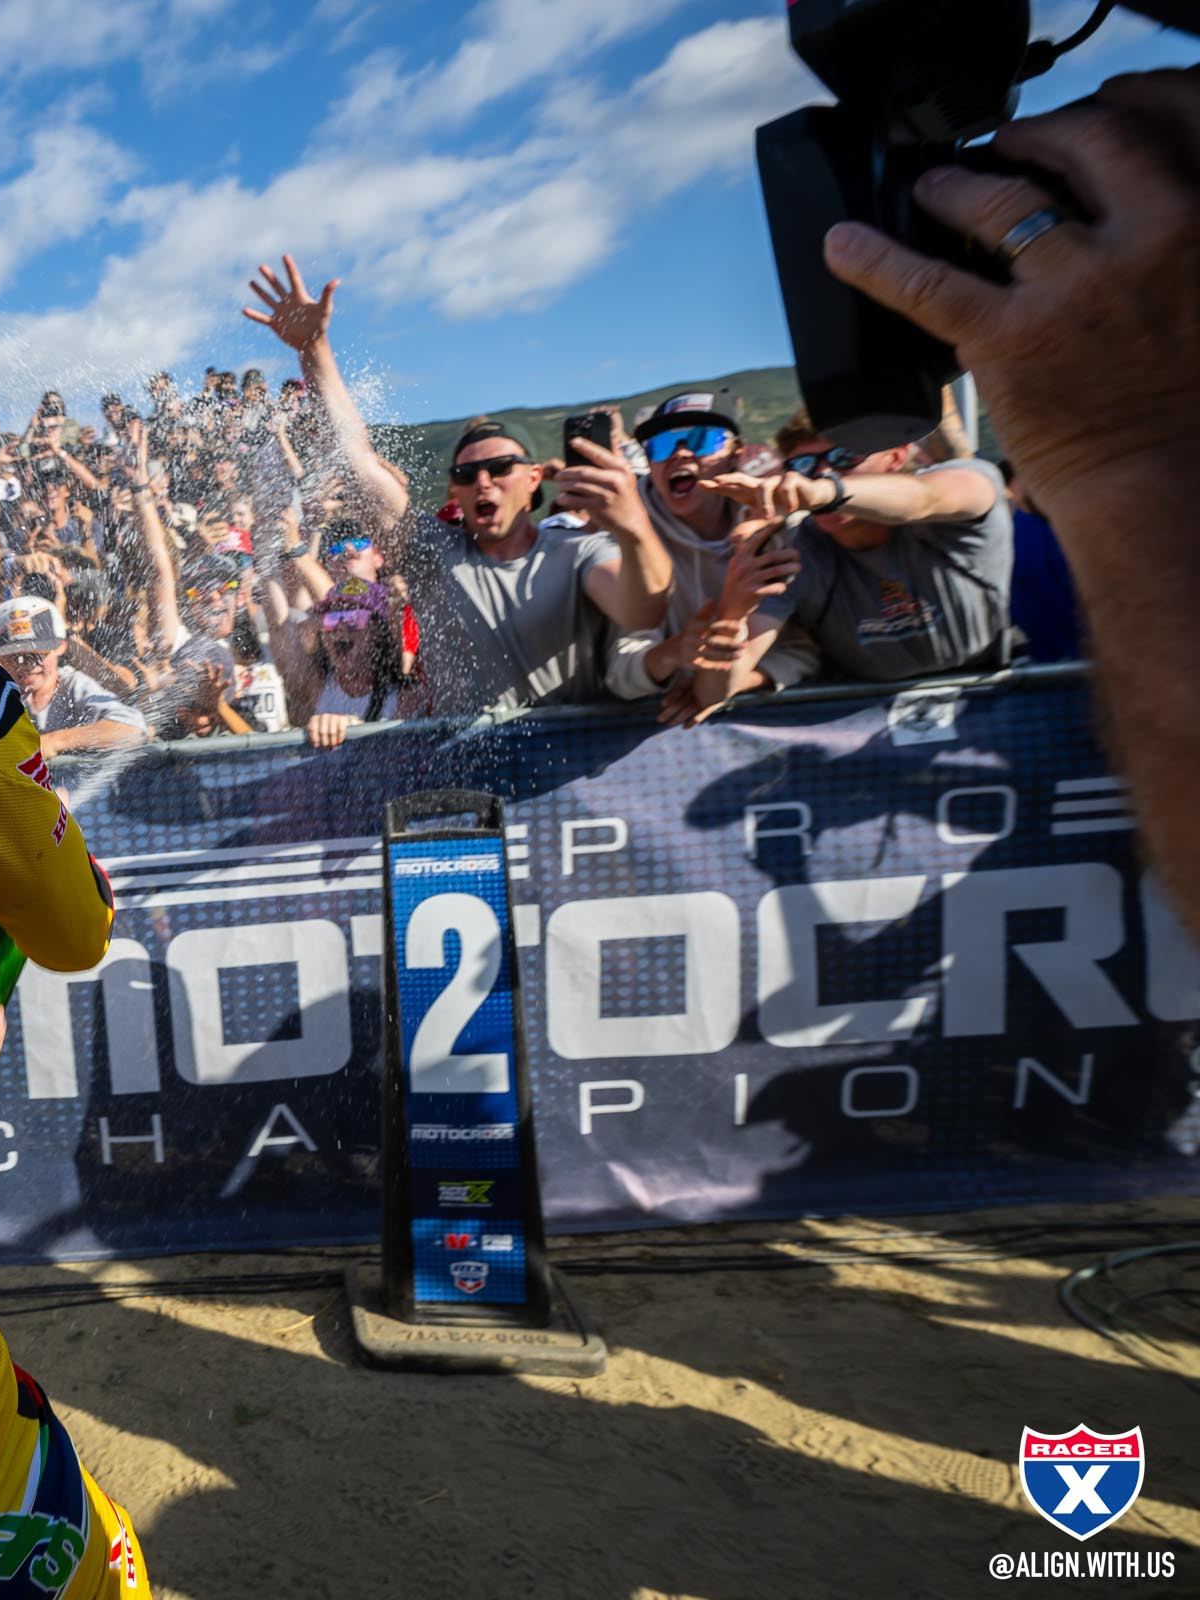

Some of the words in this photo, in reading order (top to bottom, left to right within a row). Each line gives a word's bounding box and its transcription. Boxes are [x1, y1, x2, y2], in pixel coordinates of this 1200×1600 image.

[394, 856, 500, 875] MOTOCROSS
[405, 892, 510, 1094] 2
[411, 1125, 514, 1140] MOTOCROSS
